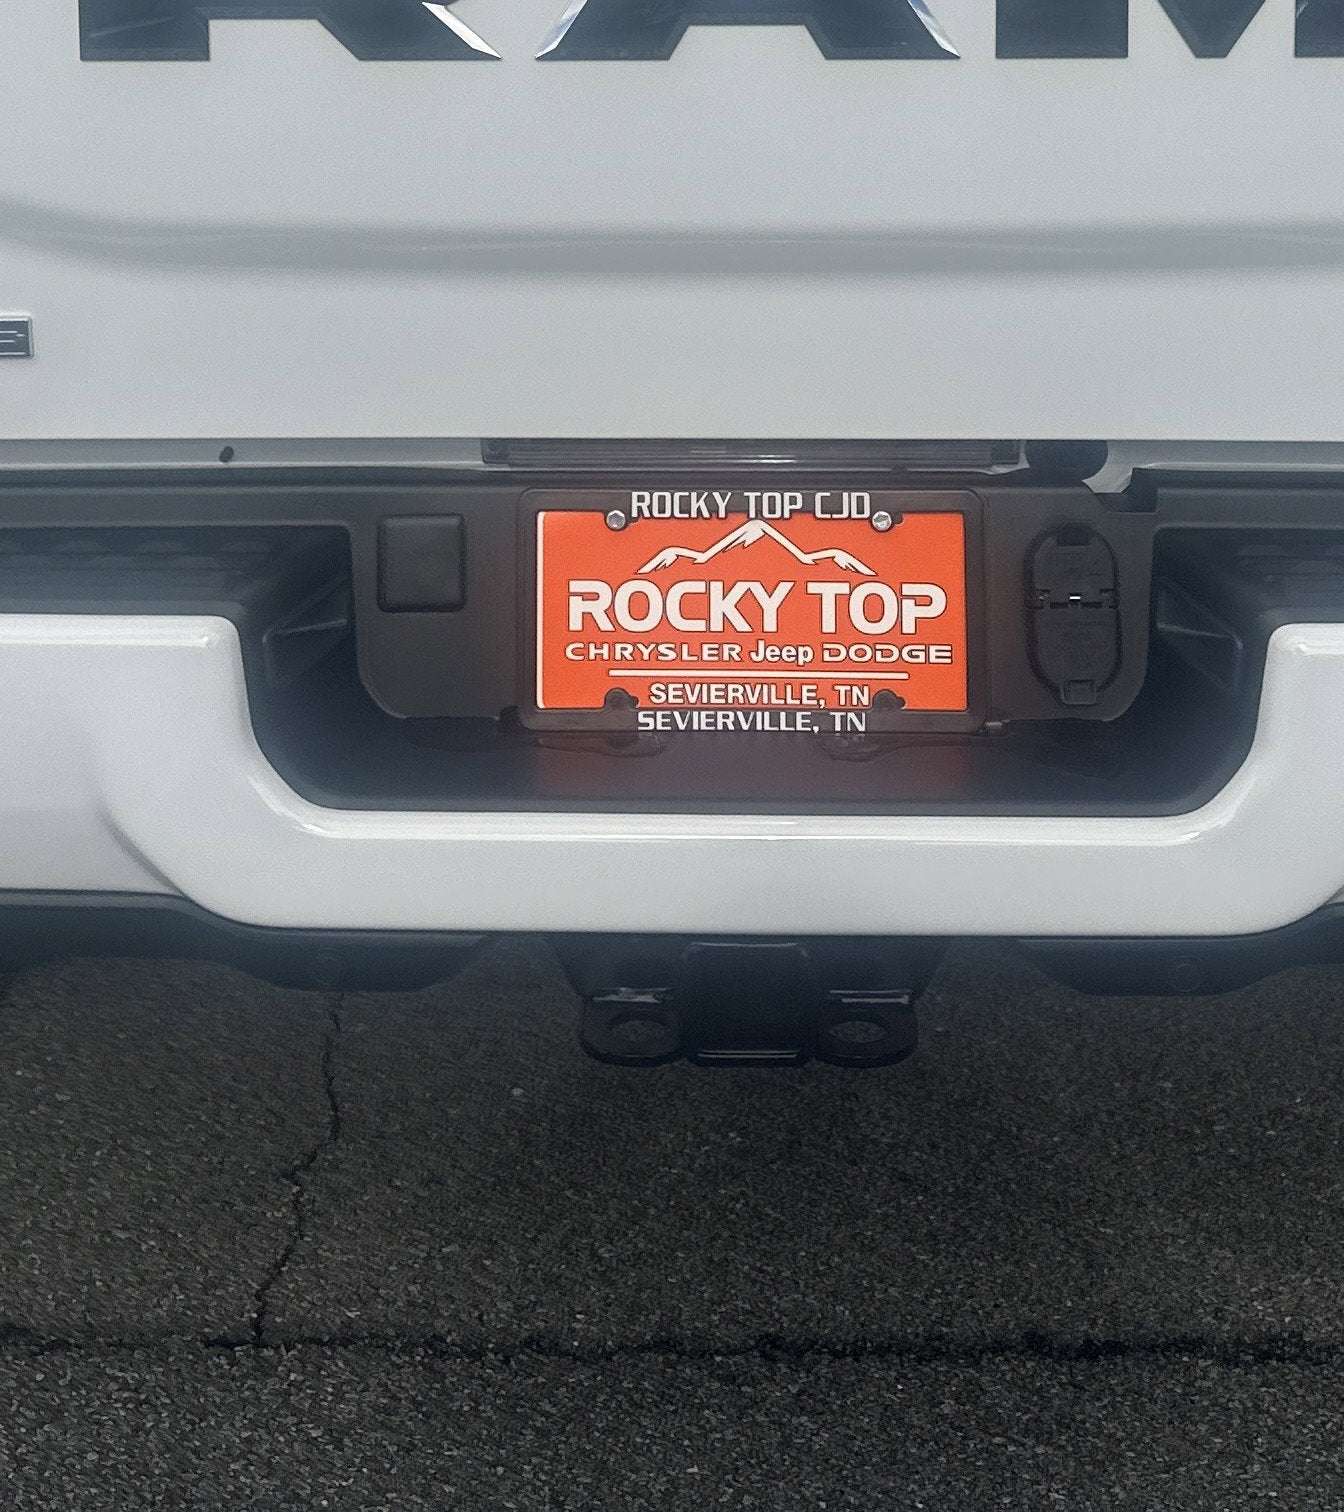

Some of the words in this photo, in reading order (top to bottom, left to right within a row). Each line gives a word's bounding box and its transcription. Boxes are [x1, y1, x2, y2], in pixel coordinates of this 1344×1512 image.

[630, 491, 731, 519] ROCKY
[743, 491, 803, 519] TOP
[814, 491, 872, 519] CJD
[567, 579, 795, 633] ROCKY
[806, 581, 948, 635] TOP
[565, 642, 742, 662] CHRYSLER
[750, 639, 814, 666] Jeep
[822, 642, 952, 664] DODGE
[649, 683, 826, 709] SEVIERVILLE,
[833, 685, 870, 707] TN
[637, 710, 820, 734] SEVIERVILLE,
[830, 710, 868, 733] TN
